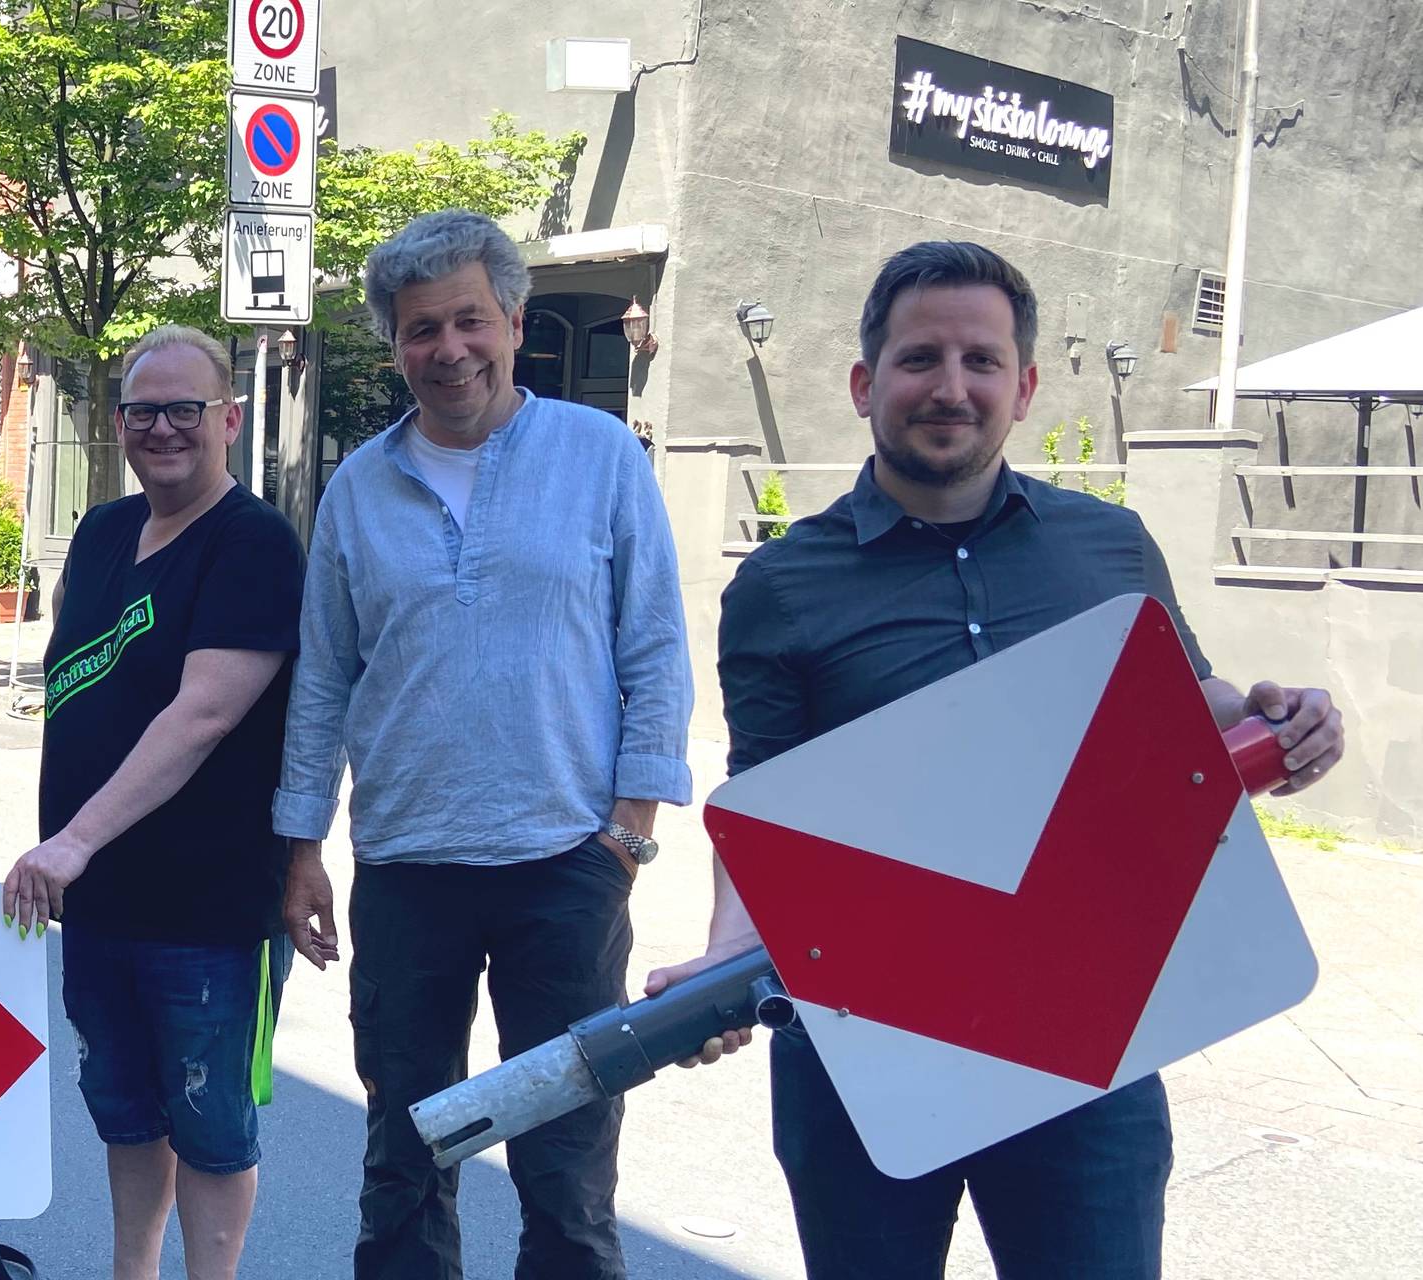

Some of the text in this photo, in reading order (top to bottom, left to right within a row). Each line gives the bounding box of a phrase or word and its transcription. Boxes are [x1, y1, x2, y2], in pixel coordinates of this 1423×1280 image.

[261, 5, 293, 39] 20
[253, 62, 296, 83] ZONE
[969, 135, 1060, 166] SMOKE DRINK CHILL
[250, 180, 293, 200] ZONE
[233, 220, 307, 241] Anlieferung!
